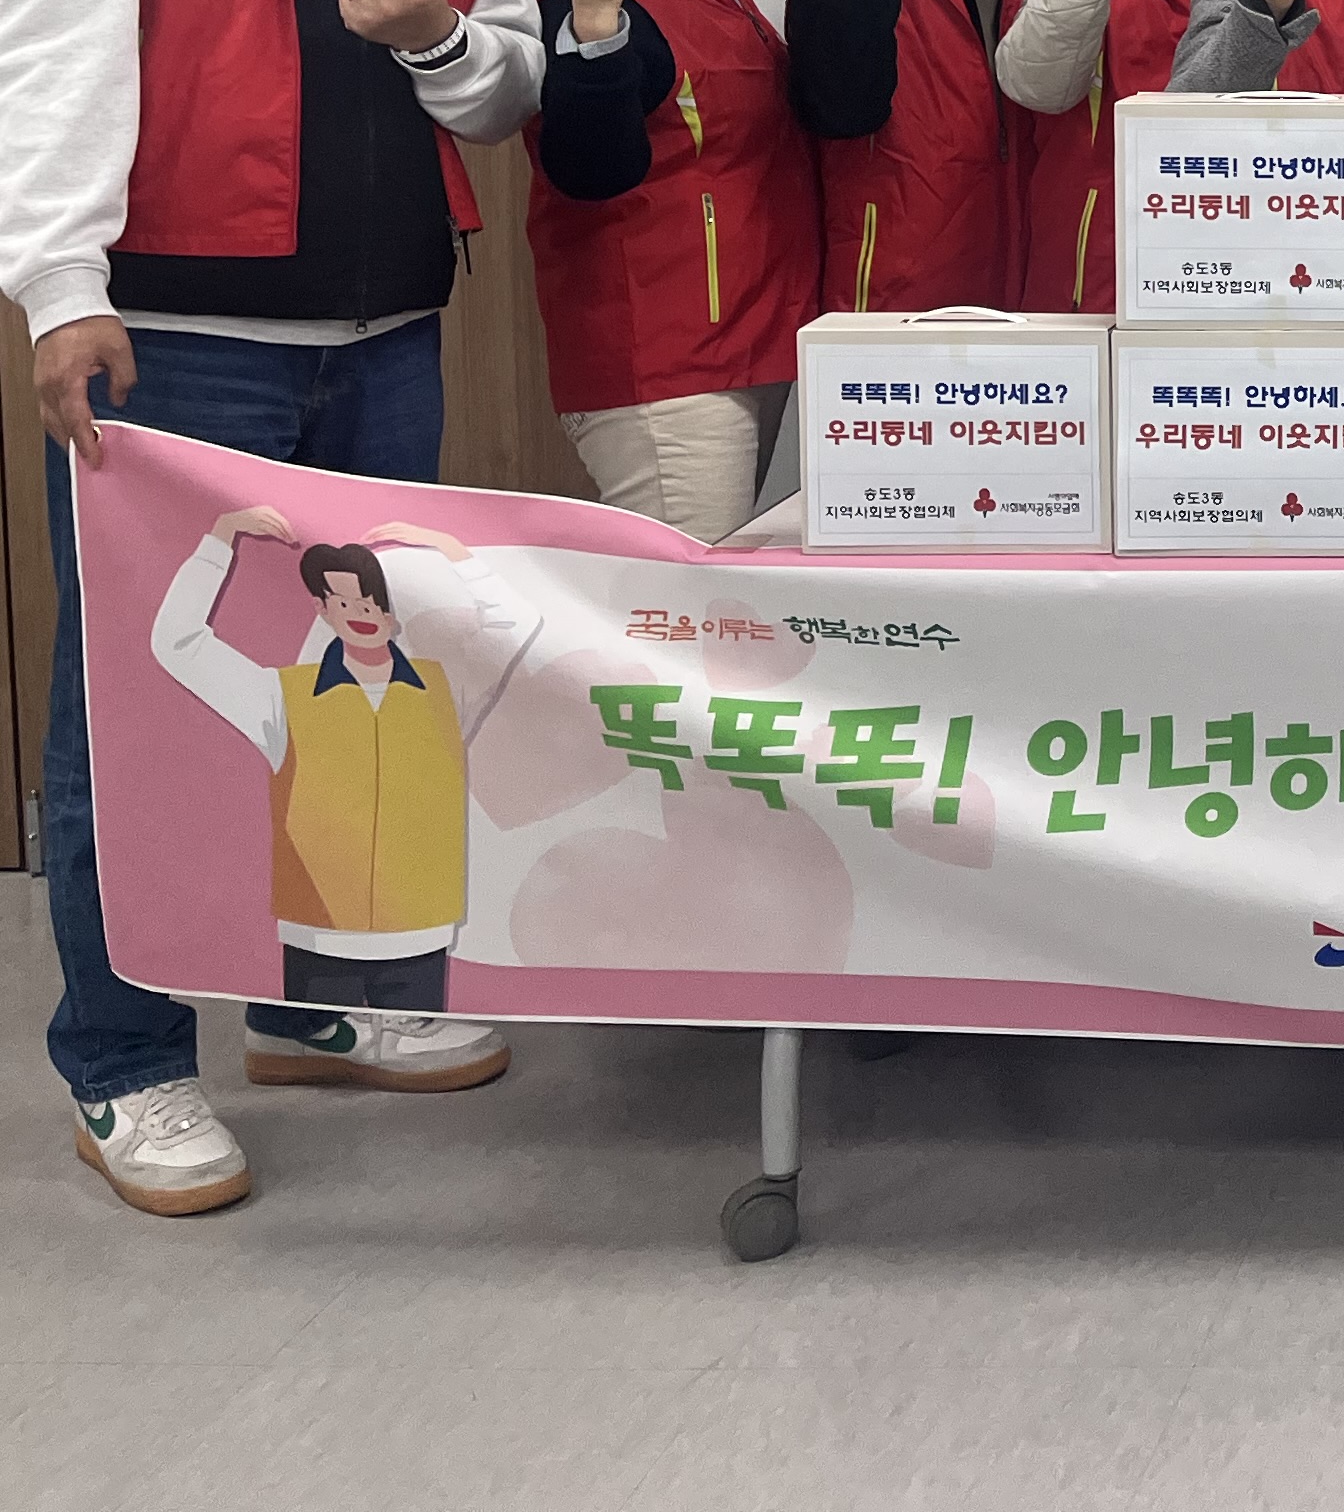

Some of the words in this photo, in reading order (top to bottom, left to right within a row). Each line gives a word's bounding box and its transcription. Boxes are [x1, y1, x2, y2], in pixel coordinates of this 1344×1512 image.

[1159, 155, 1238, 179] 똑똑똑!
[1142, 193, 1251, 221] 우리동네
[1180, 261, 1233, 277] 송도3동
[1142, 279, 1272, 295] 지역사회보장협의체
[840, 382, 920, 405] 똑똑똑!
[934, 381, 1069, 406] 안녕하세요?
[1151, 385, 1231, 409] 똑똑똑!
[824, 419, 933, 447] 우리동네
[949, 419, 1086, 446] 이웃지킴이
[1135, 422, 1243, 451] 우리동네
[863, 487, 916, 502] 송도3동
[1172, 491, 1224, 506] 송도3동
[824, 505, 956, 520] 지역사회보장협의체
[1134, 509, 1264, 524] 지역사회보장협의체
[587, 683, 975, 829] 똑똑똑!
